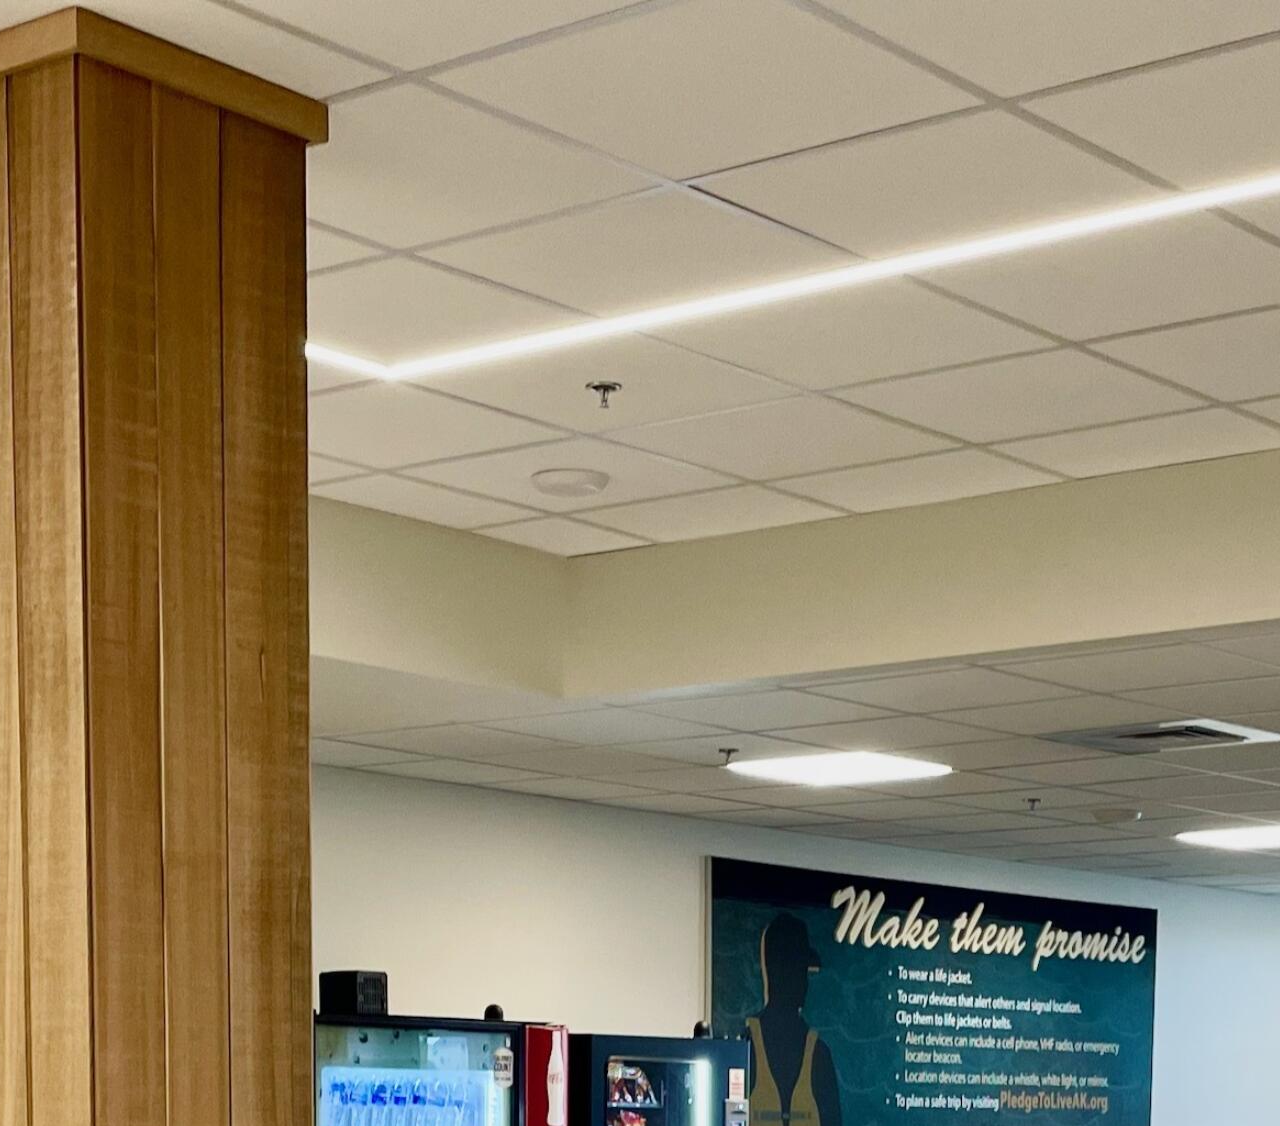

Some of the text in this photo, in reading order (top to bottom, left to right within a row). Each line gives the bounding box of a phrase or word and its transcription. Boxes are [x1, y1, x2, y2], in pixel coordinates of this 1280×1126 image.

[832, 886, 1146, 972] Make them promise
[898, 966, 973, 986] To wear a life jacket.
[897, 989, 1082, 1015] To carry devices that alert others and signal location.
[895, 1009, 1012, 1030] Clip them to life jackets or belts.
[905, 1031, 925, 1046] Alert
[925, 1032, 953, 1047] devices
[954, 1036, 968, 1047] can
[969, 1034, 996, 1049] include
[996, 1038, 1001, 1048] a
[1002, 1036, 1014, 1048] cell
[1083, 1042, 1120, 1056] emergency
[905, 1048, 932, 1063] locator
[905, 1069, 938, 1083] Location
[938, 1070, 966, 1084] devices
[967, 1073, 981, 1084] can
[981, 1071, 1008, 1085] include
[1008, 1075, 1014, 1085] a
[1041, 1073, 1060, 1086] white
[895, 1089, 1108, 1114] To plan a safe trip by visiting PledgeToLiveAK.org
